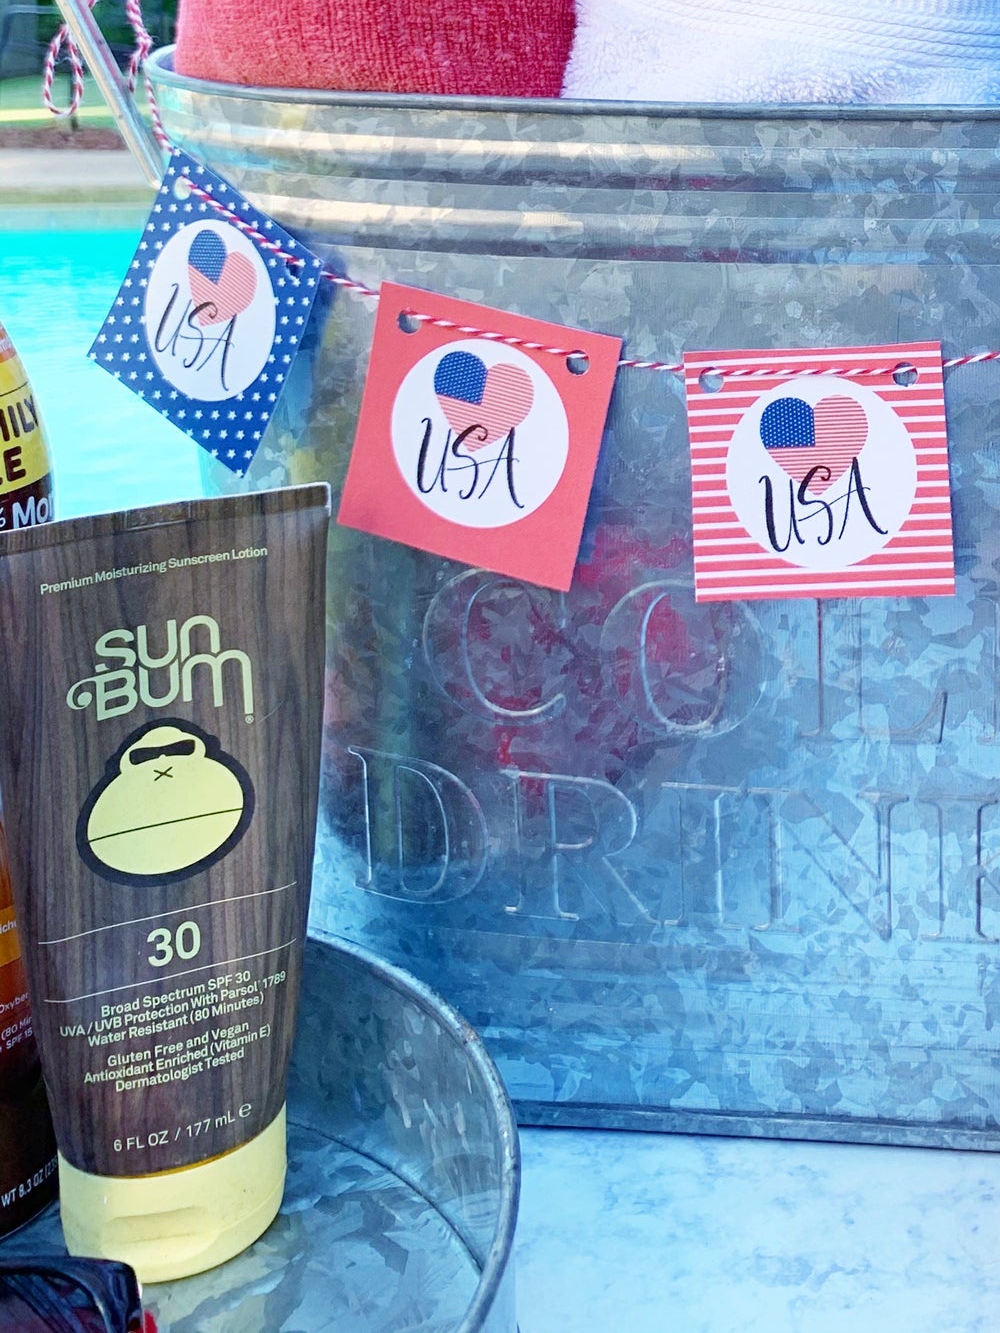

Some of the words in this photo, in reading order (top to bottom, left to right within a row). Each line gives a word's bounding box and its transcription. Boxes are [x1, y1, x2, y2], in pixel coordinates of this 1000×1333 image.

[155, 282, 235, 391] USA
[0, 445, 27, 486] E
[417, 416, 526, 510] USA
[757, 455, 889, 554] USA
[40, 575, 94, 595] Premium
[95, 560, 167, 582] Moisturizing
[168, 551, 230, 569] Sunscreen
[231, 546, 268, 560] Lotion
[146, 920, 201, 967] 30
[101, 997, 140, 1018] Broad
[142, 983, 206, 1012] Spectrum
[207, 973, 233, 991] SPF
[235, 970, 251, 985] 30
[124, 1000, 189, 1027] Protection
[190, 994, 219, 1011] With
[262, 971, 286, 990] 1789
[6, 1033, 23, 1050] SPF
[88, 1029, 126, 1048] Water
[128, 1014, 189, 1039] Resistant
[189, 1008, 210, 1027] (80
[211, 992, 265, 1018] Minutes)
[84, 1062, 154, 1085] Antioxidant
[156, 1046, 209, 1072] Enriched
[210, 1030, 258, 1057] (Vitamin
[259, 1024, 271, 1040] E)
[107, 1050, 151, 1068] Gluten
[154, 1042, 184, 1058] Free
[185, 1035, 209, 1051] and
[211, 1022, 249, 1044] Vegan
[115, 1060, 204, 1093] Dermatologist
[204, 1047, 245, 1068] Tested
[113, 1138, 123, 1152] 6
[126, 1134, 145, 1150] FL
[148, 1130, 169, 1146] OZ
[186, 1118, 212, 1138] 177
[215, 1110, 236, 1129] mL
[1, 1187, 17, 1207] WT
[18, 1178, 32, 1198] 8.3
[33, 1168, 44, 1187] OZ
